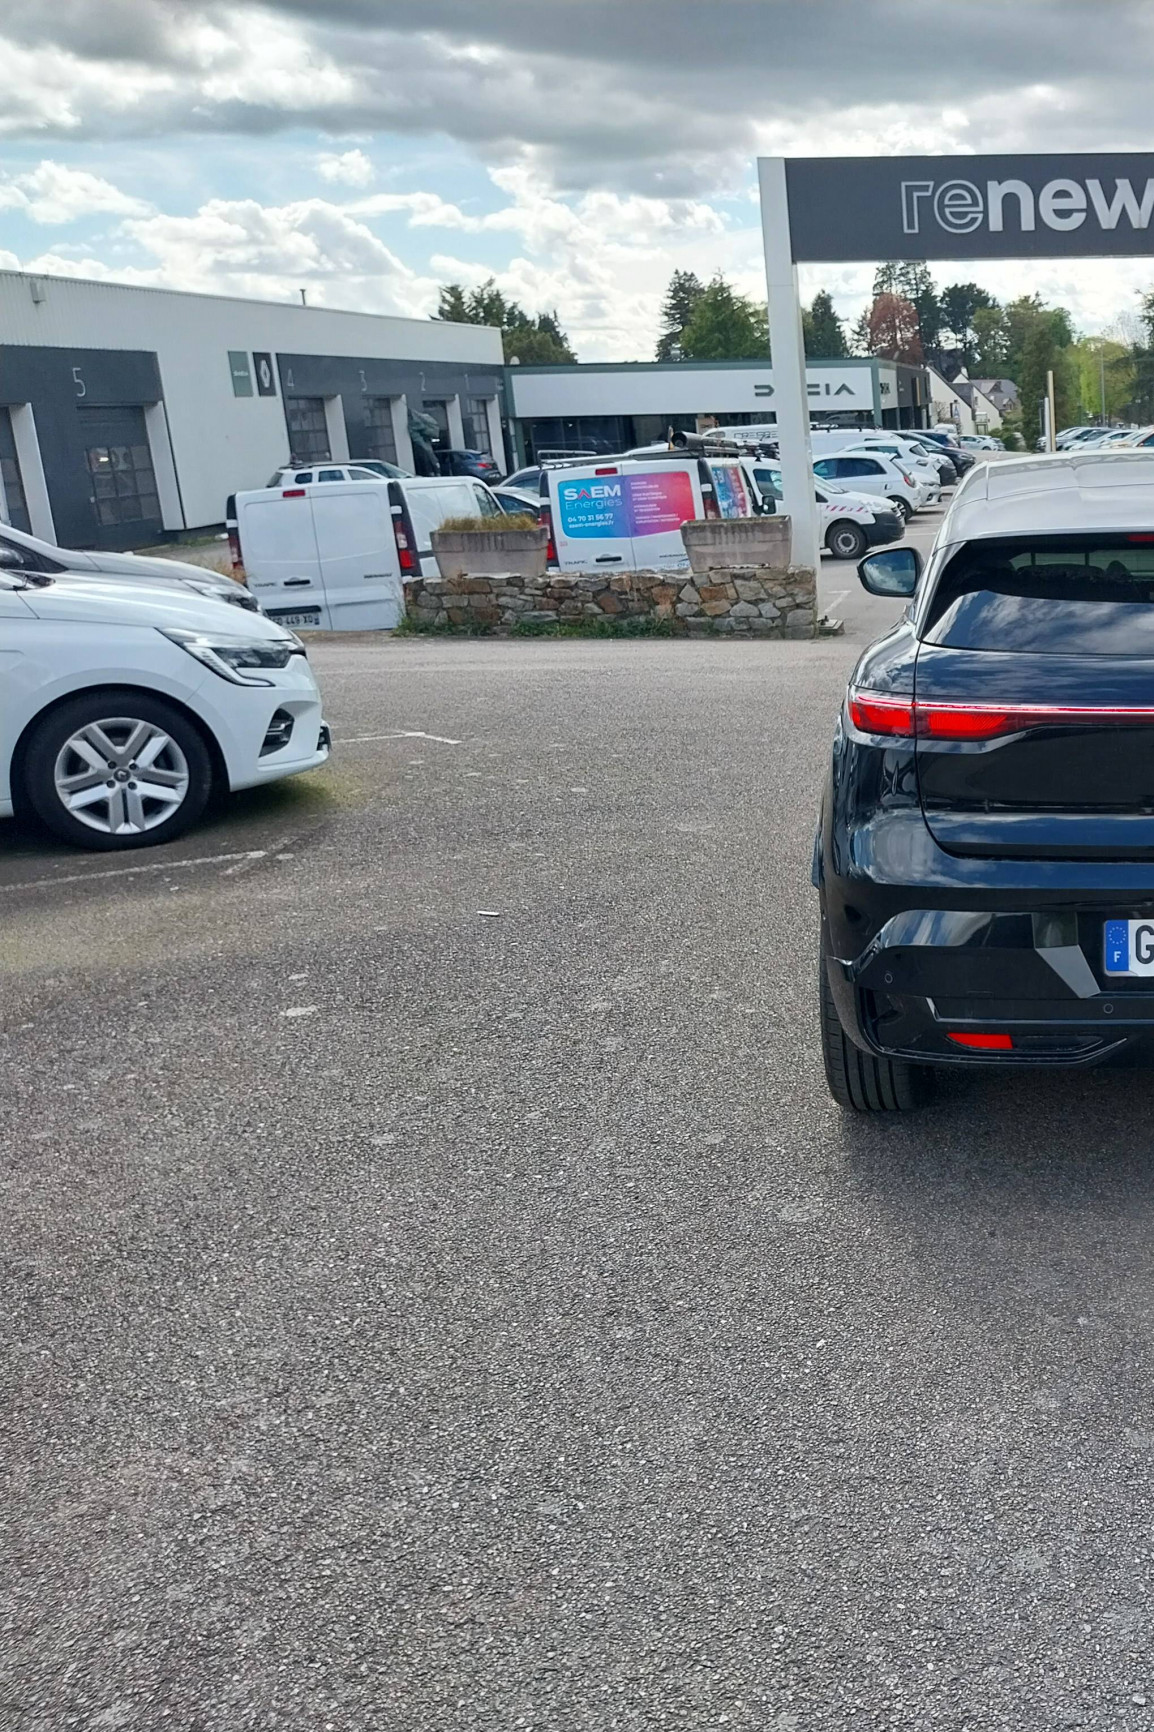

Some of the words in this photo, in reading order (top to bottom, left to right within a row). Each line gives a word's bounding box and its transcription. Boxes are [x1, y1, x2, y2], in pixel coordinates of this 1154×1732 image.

[72, 367, 86, 397] 5
[287, 368, 295, 390] 4
[754, 383, 856, 397] DCIA
[563, 484, 621, 500] SAEM
[565, 498, 623, 511] Energies
[1113, 951, 1121, 962] F
